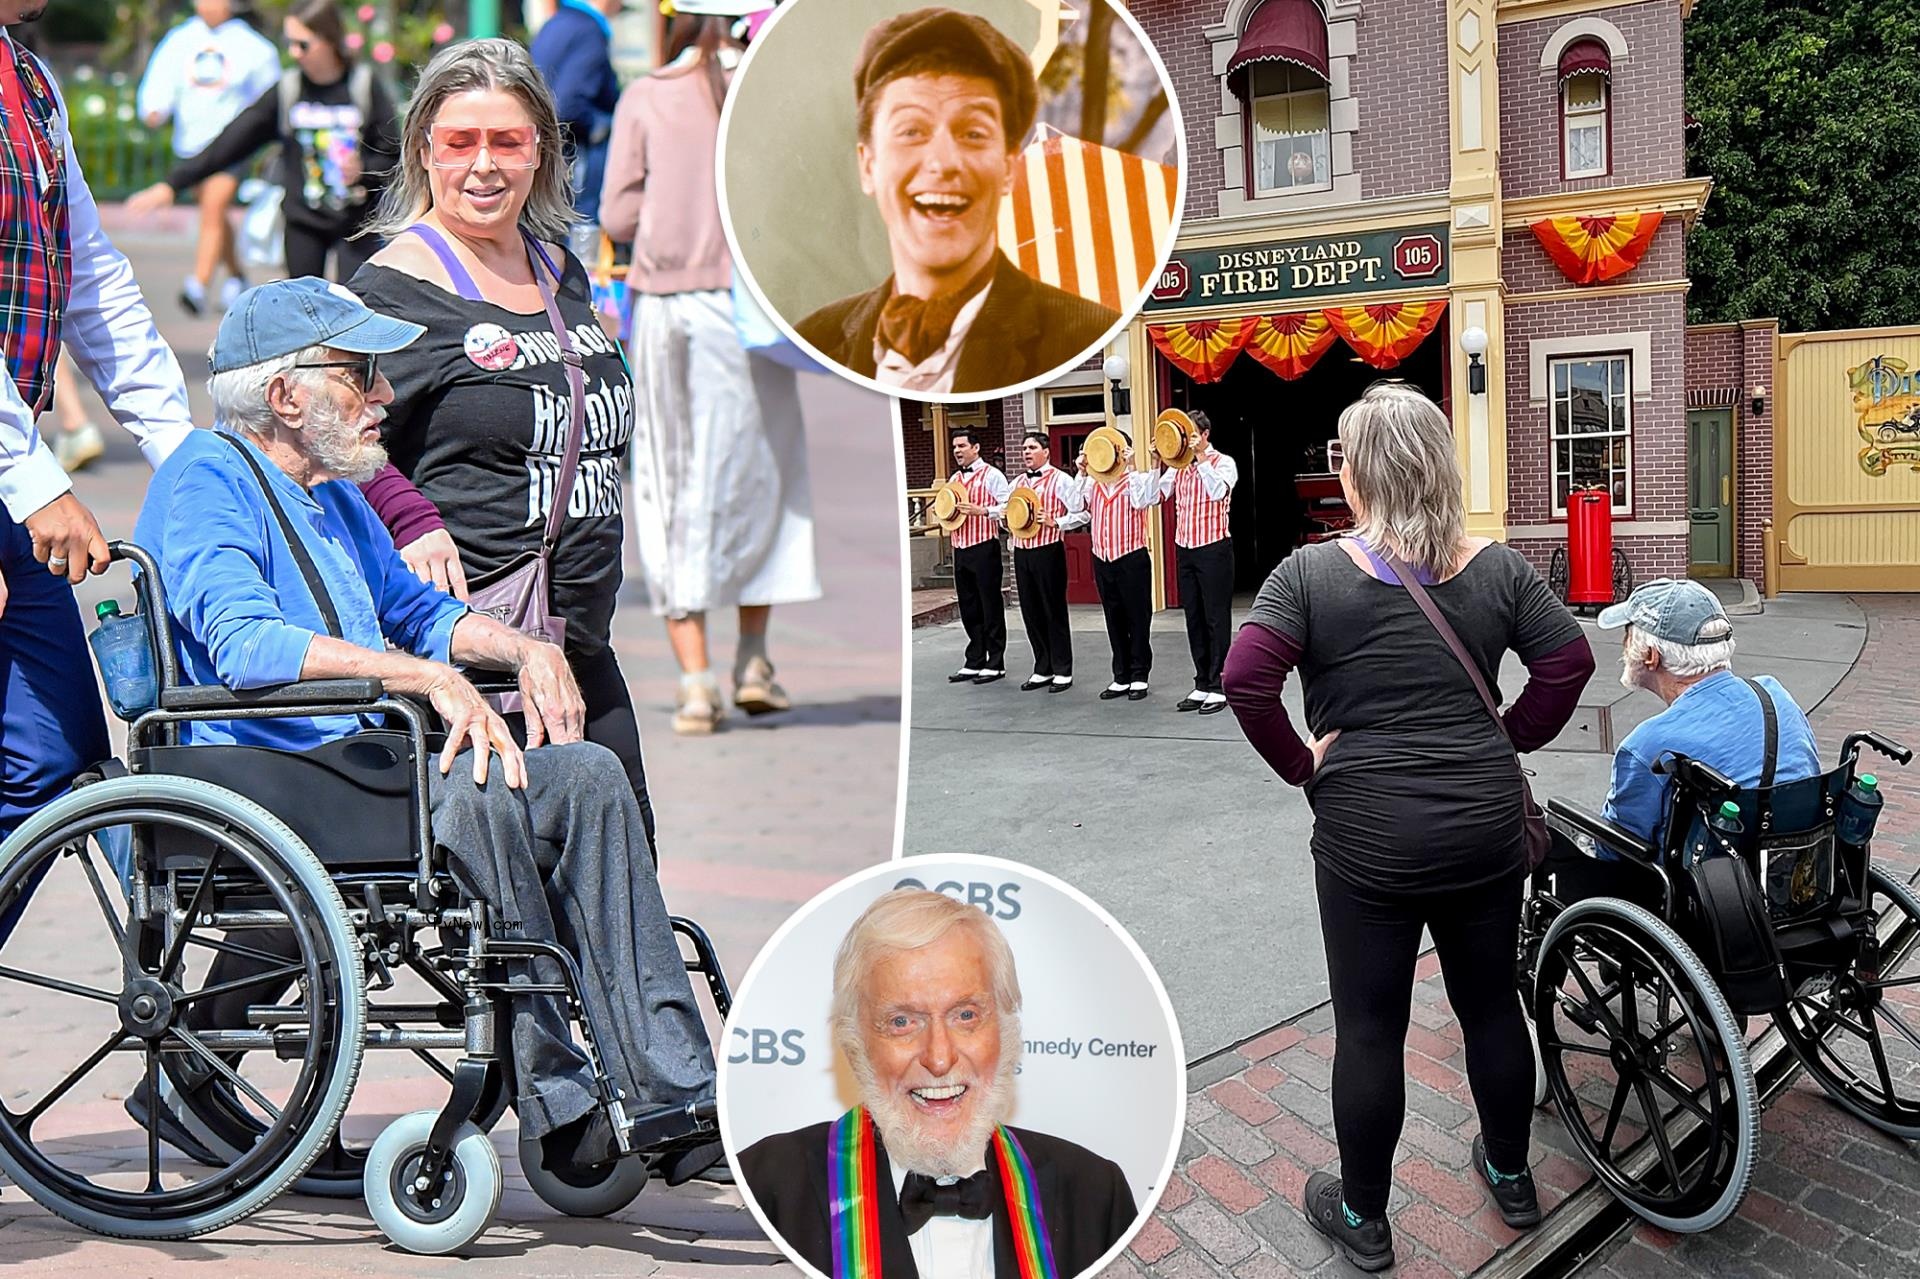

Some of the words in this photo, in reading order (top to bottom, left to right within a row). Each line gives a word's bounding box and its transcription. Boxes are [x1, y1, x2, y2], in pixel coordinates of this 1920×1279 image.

[1218, 241, 1362, 271] DISNEYLAND
[1404, 245, 1432, 266] 105
[1199, 267, 1280, 298] FIRE
[1290, 257, 1387, 289] DEPT.
[1022, 1037, 1083, 1059] nnedy
[1088, 1038, 1158, 1058] Center
